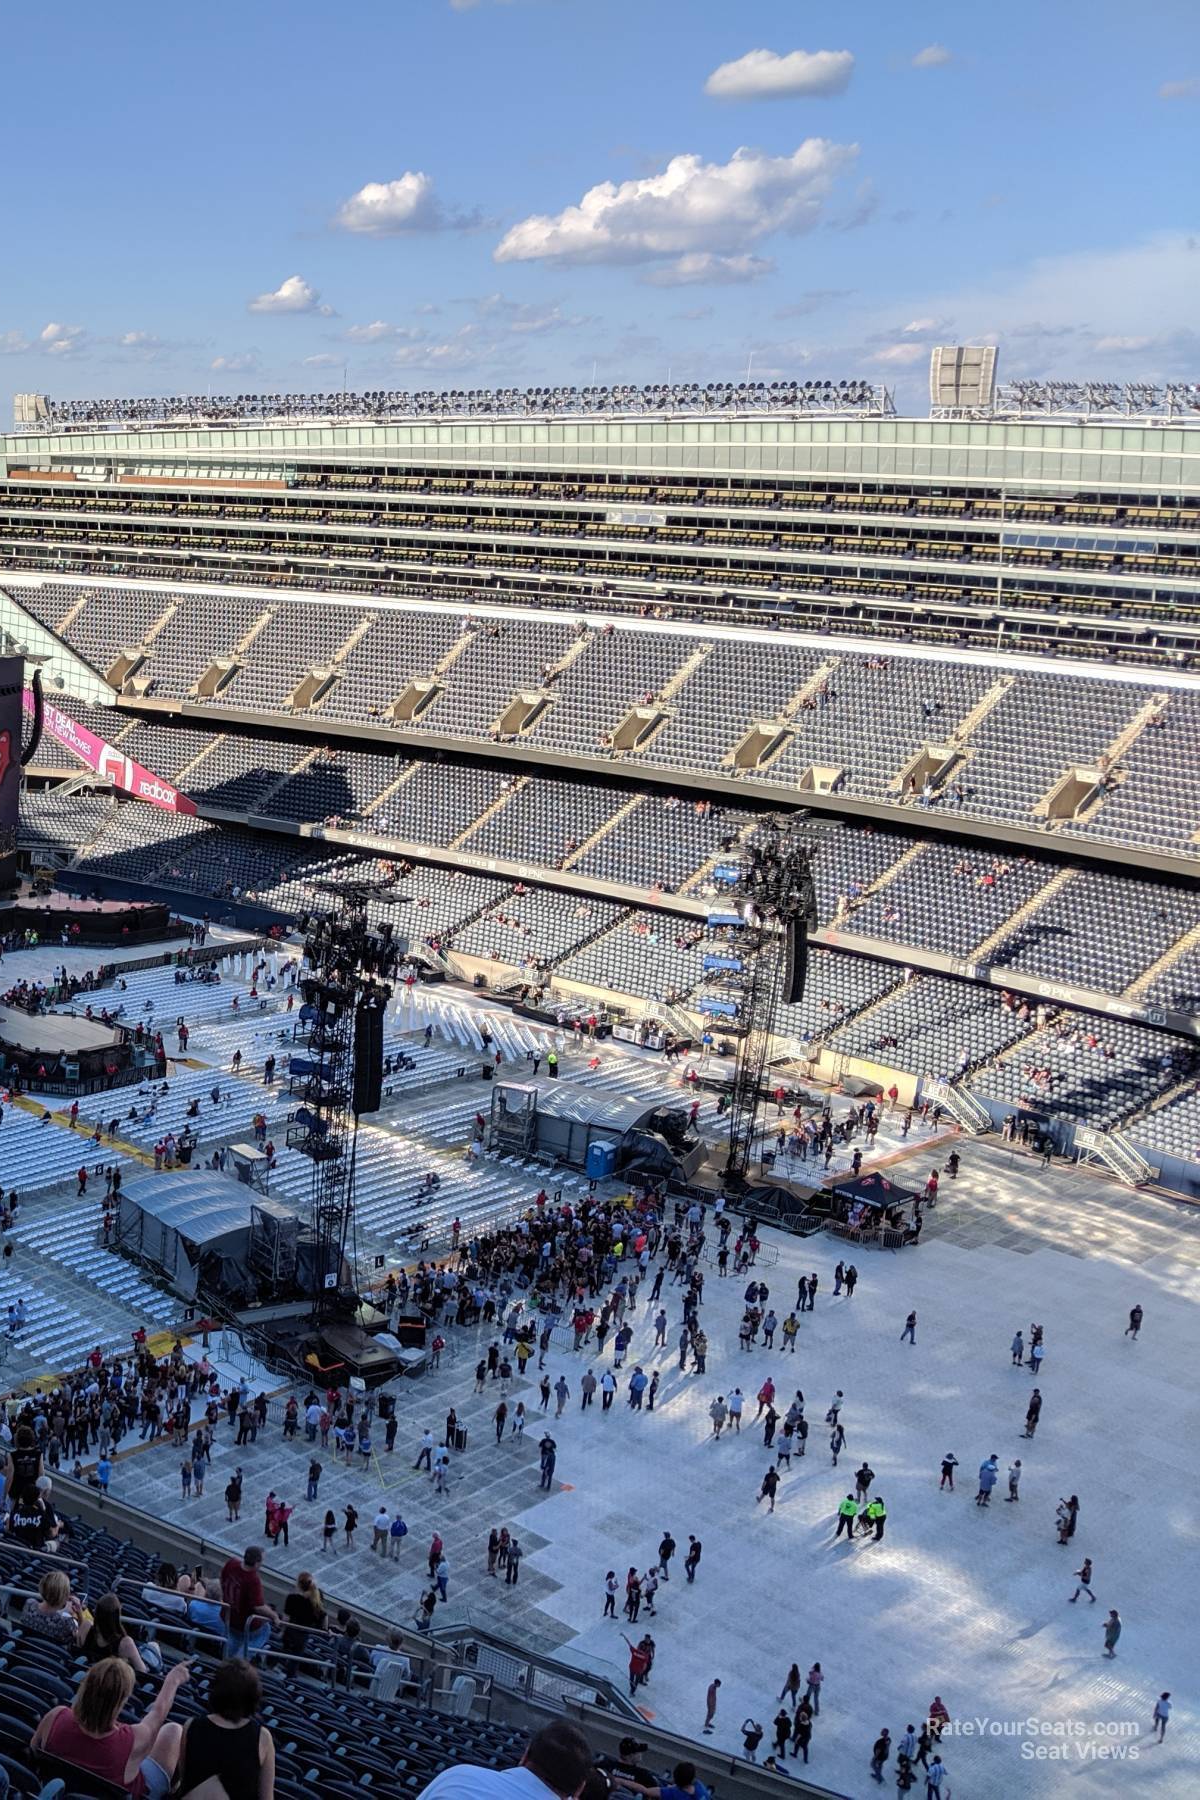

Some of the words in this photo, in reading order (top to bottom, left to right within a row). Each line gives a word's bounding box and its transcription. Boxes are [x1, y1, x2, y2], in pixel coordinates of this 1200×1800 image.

[55, 711, 76, 736] DEAL
[54, 723, 70, 740] NEW
[69, 730, 92, 756] MOVIES
[139, 780, 177, 805] redbox
[356, 837, 396, 851] Advocate
[528, 868, 546, 881] PNC
[1052, 985, 1075, 1002] PNC
[13, 1513, 42, 1528] Stones
